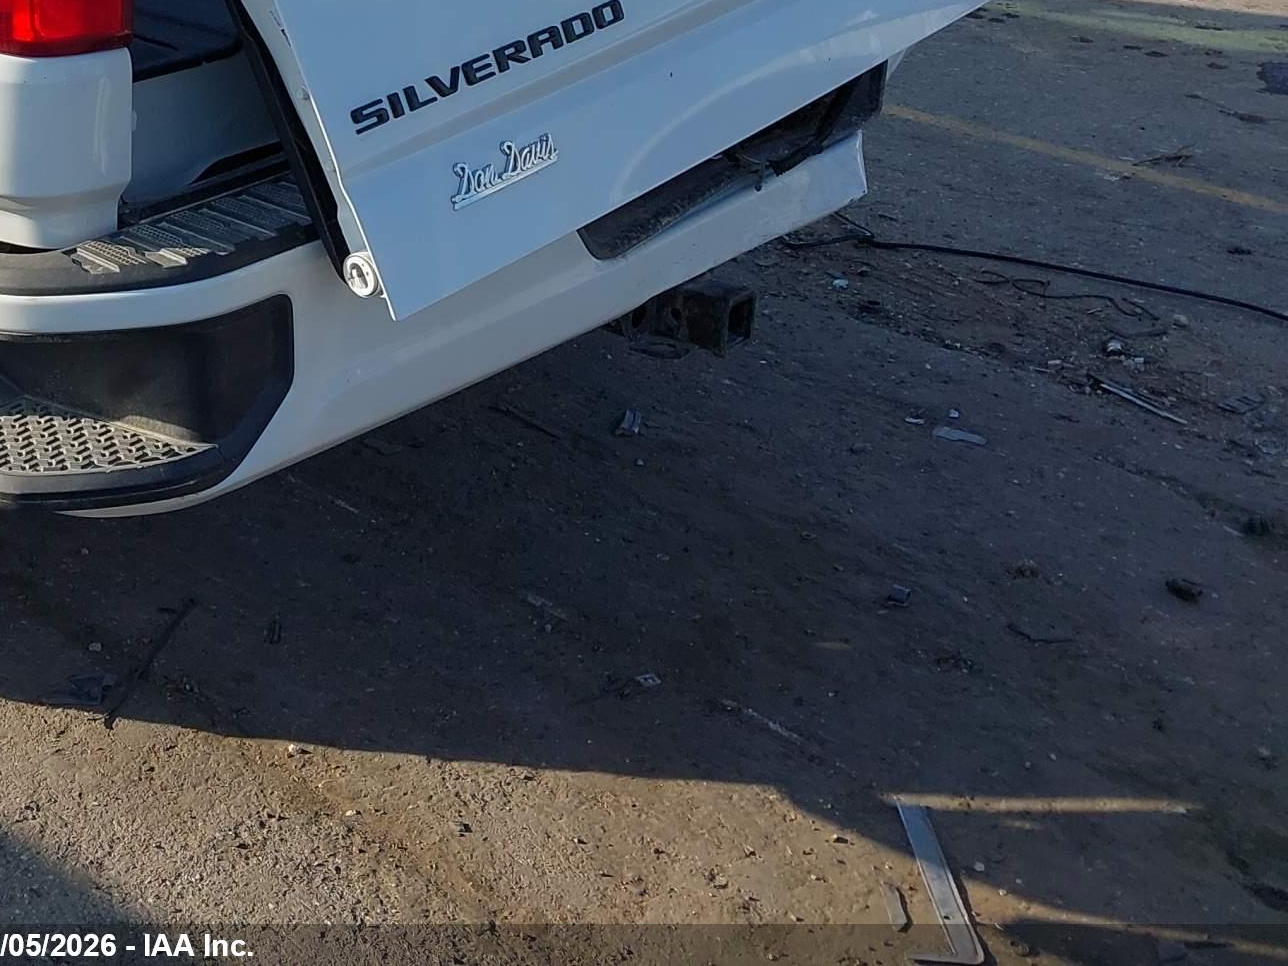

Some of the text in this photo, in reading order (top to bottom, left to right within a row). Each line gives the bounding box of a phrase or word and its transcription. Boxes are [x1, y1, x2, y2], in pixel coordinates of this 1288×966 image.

[350, 0, 625, 135] SILVERADO
[451, 133, 559, 202] Don Davis
